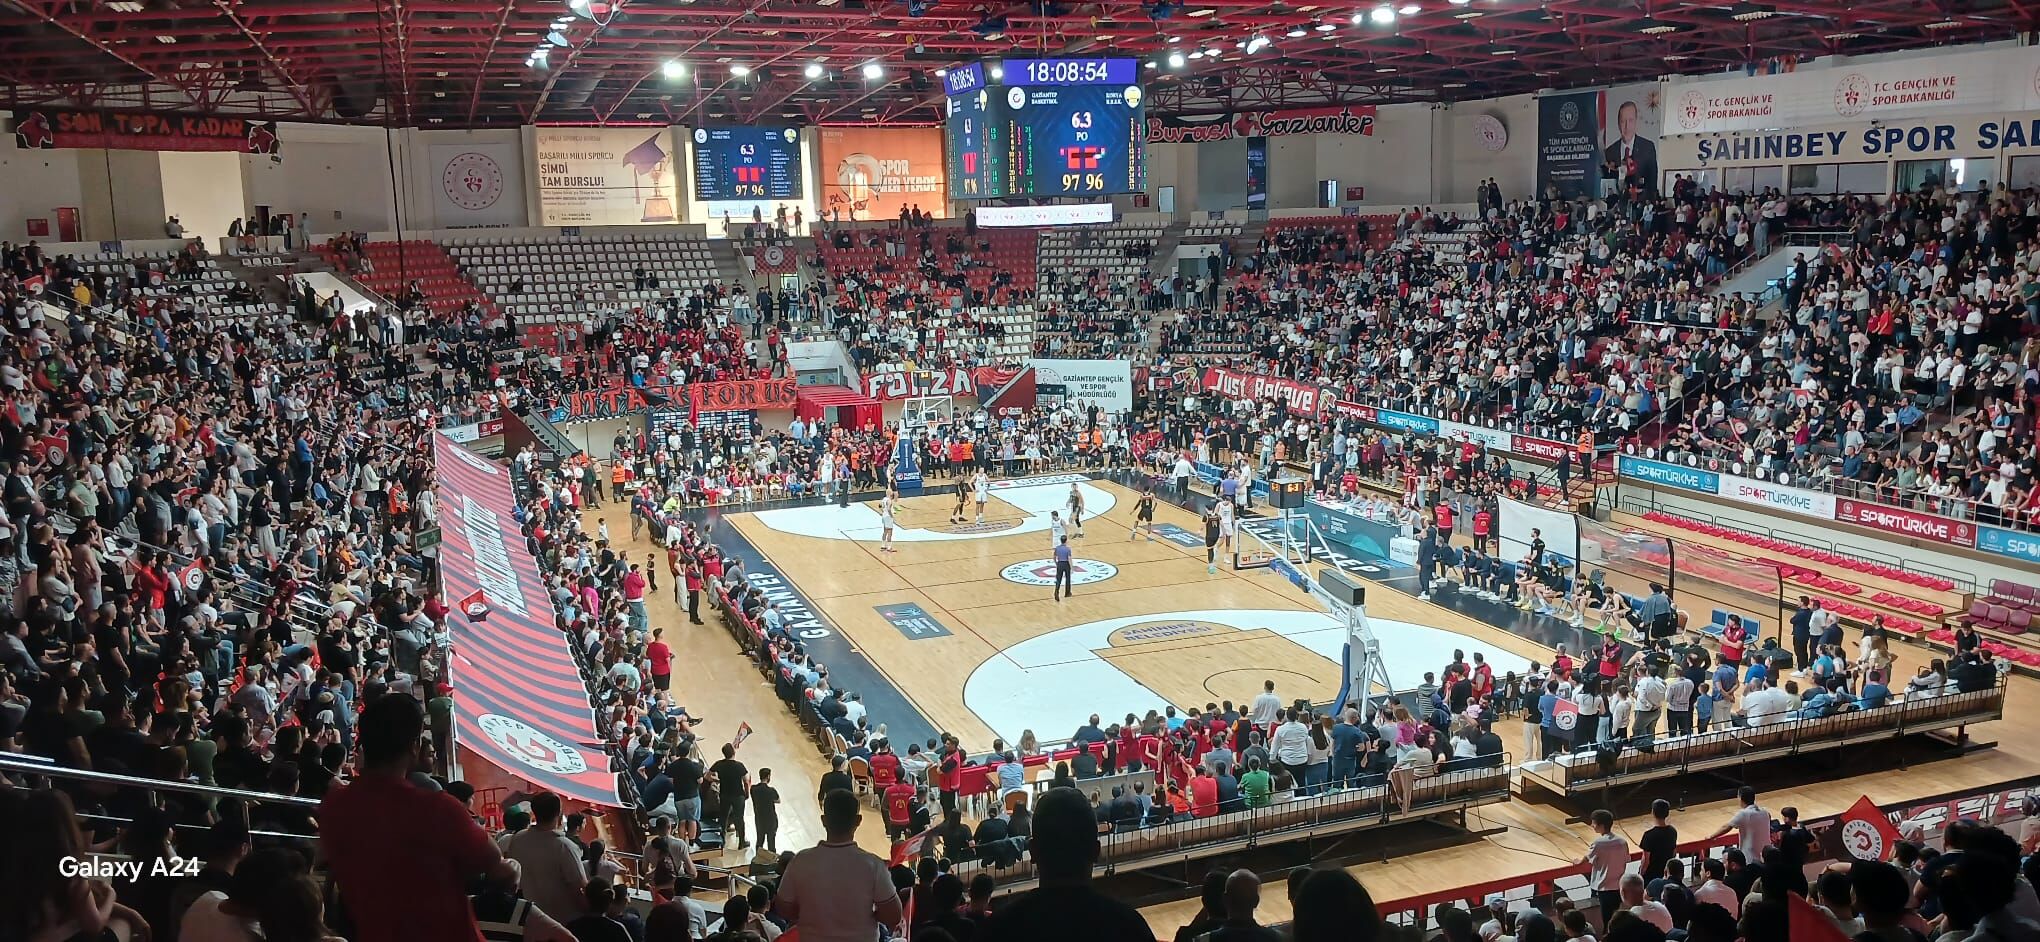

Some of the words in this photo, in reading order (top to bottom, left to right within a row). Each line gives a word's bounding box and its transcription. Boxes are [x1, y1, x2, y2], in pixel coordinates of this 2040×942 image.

[1027, 62, 1107, 81] 18:08:54
[1943, 76, 1956, 86] VE
[1762, 94, 1773, 103] VE
[1872, 96, 1897, 106] SPOR
[1072, 112, 1091, 128] 6.3
[1707, 110, 1727, 119] SPOR
[183, 117, 244, 136] KADAR
[1076, 132, 1088, 141] PO
[1863, 125, 1955, 155] SPOR
[740, 144, 755, 155] 6.3
[880, 160, 909, 175] SPOR
[542, 177, 561, 187] TAM
[564, 176, 604, 187] BURSLU!
[1063, 174, 1080, 191] 97
[1086, 173, 1103, 190] 96
[735, 185, 748, 196] 97
[752, 185, 764, 196] 96
[1062, 374, 1096, 382] GAZİANTEP
[1208, 369, 1246, 397] Just
[570, 386, 685, 417] ATTAK
[702, 384, 756, 405] FOR
[765, 383, 796, 402] US
[1637, 465, 1699, 487] SPORTÜRKİYE
[1740, 485, 1810, 510] SPORTÜRKİYE
[1860, 509, 1948, 538] SPORTÜRKİYE
